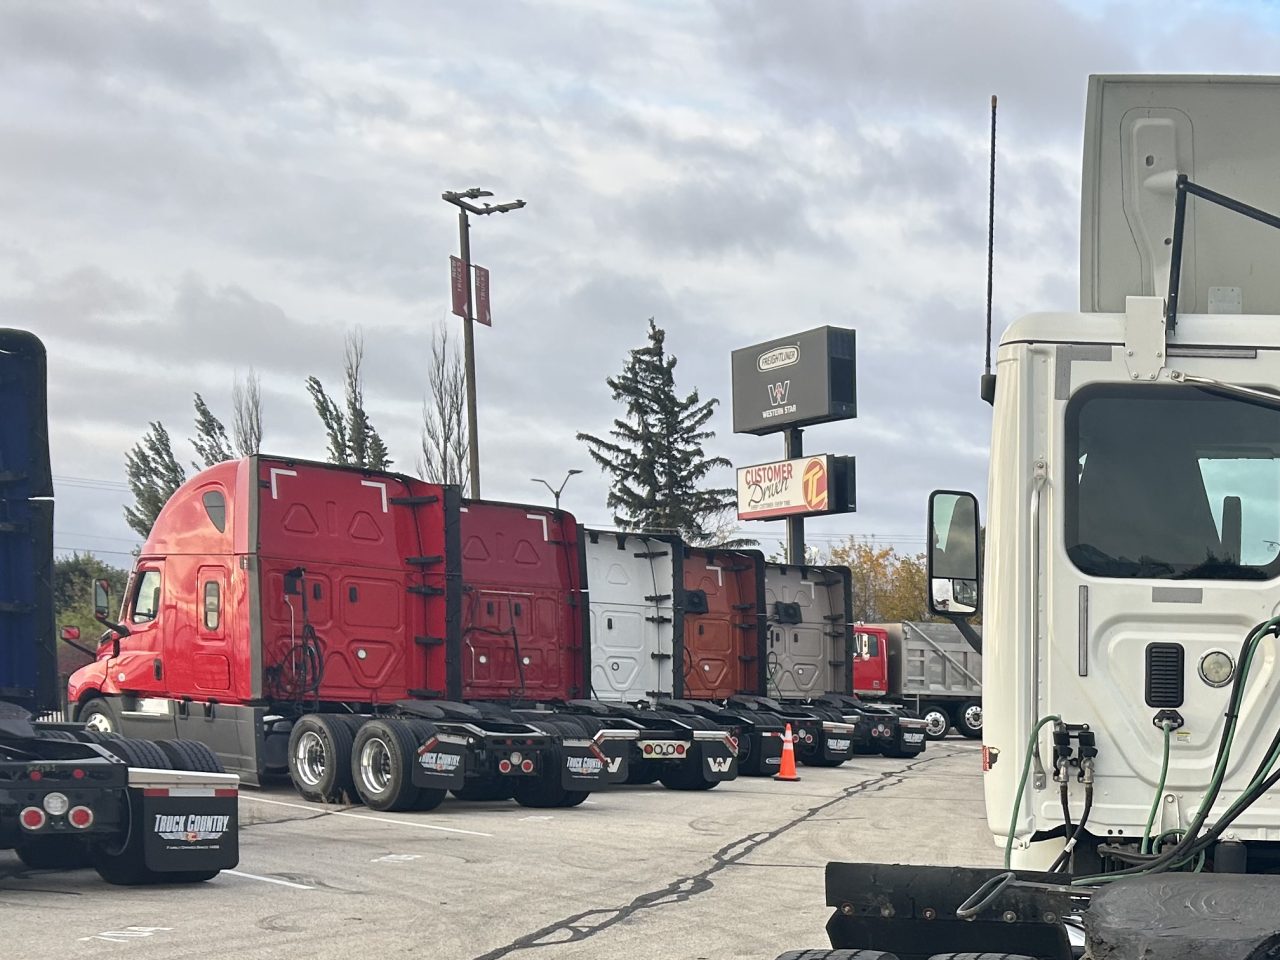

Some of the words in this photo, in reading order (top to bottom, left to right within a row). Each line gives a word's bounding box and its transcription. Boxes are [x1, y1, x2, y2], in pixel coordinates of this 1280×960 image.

[761, 350, 796, 367] FREIGHTLINER
[762, 407, 784, 419] WESTERN
[784, 404, 797, 414] STAR
[745, 462, 793, 486] CUSTOMER
[747, 478, 789, 508] Driven
[154, 814, 187, 832] TRUCK
[186, 814, 230, 832] COUNTRY
